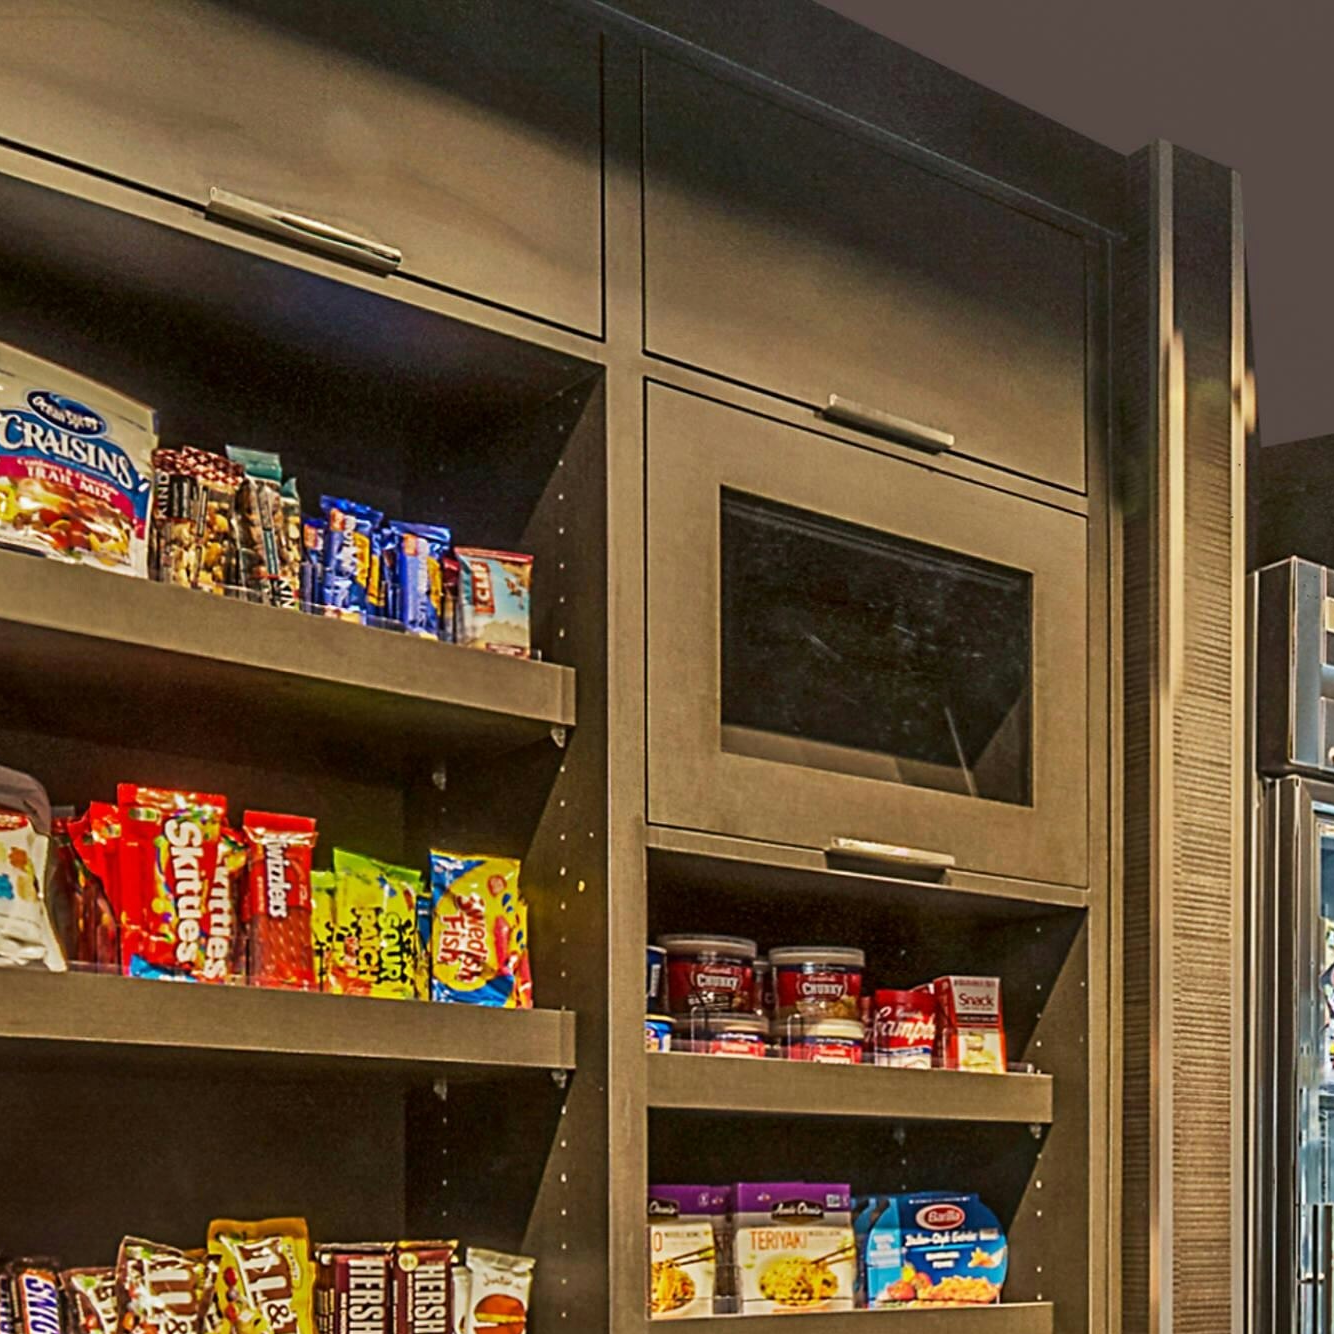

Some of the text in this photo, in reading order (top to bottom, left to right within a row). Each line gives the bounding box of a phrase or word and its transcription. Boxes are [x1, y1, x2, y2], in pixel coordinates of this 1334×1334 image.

[28, 465, 112, 502] TRAIL MIX
[156, 471, 170, 519] KIND
[471, 561, 490, 602] CLIF
[165, 819, 203, 963] Skittles
[357, 908, 379, 981] PATCH
[378, 911, 402, 981] SOUR
[438, 913, 465, 965] Fish
[455, 893, 488, 983] Swedish
[696, 973, 739, 991] CHUNKY
[801, 981, 844, 997] CHUNKY
[959, 992, 995, 1008] Snack
[927, 1209, 961, 1224] Barilla
[749, 1231, 808, 1250] TERIYAKI
